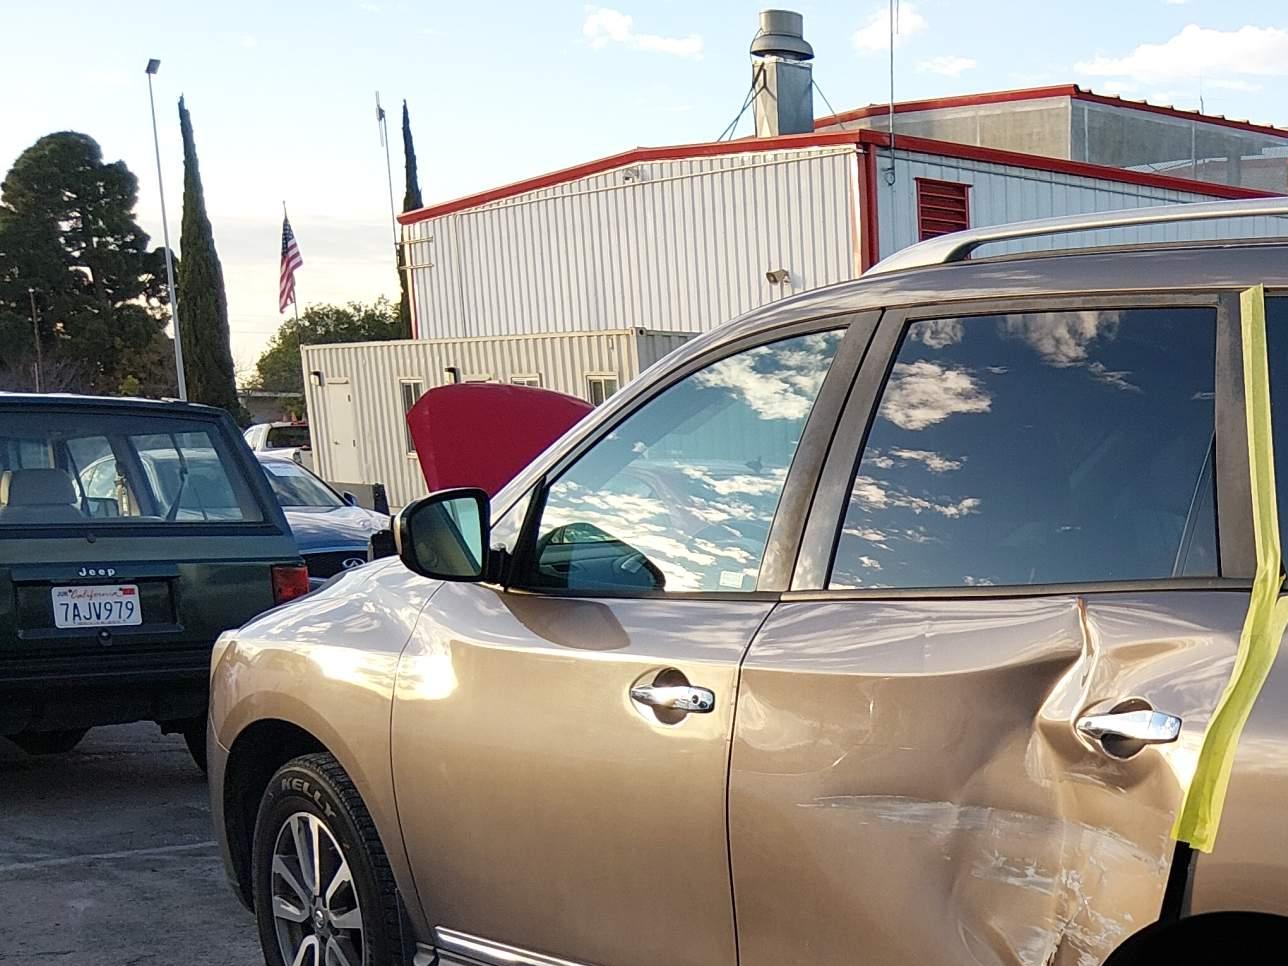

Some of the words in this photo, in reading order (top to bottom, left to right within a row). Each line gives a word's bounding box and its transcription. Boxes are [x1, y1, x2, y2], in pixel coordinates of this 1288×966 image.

[78, 567, 116, 577] Jeep
[59, 600, 135, 622] 7AJV979
[281, 776, 337, 818] KELLY
